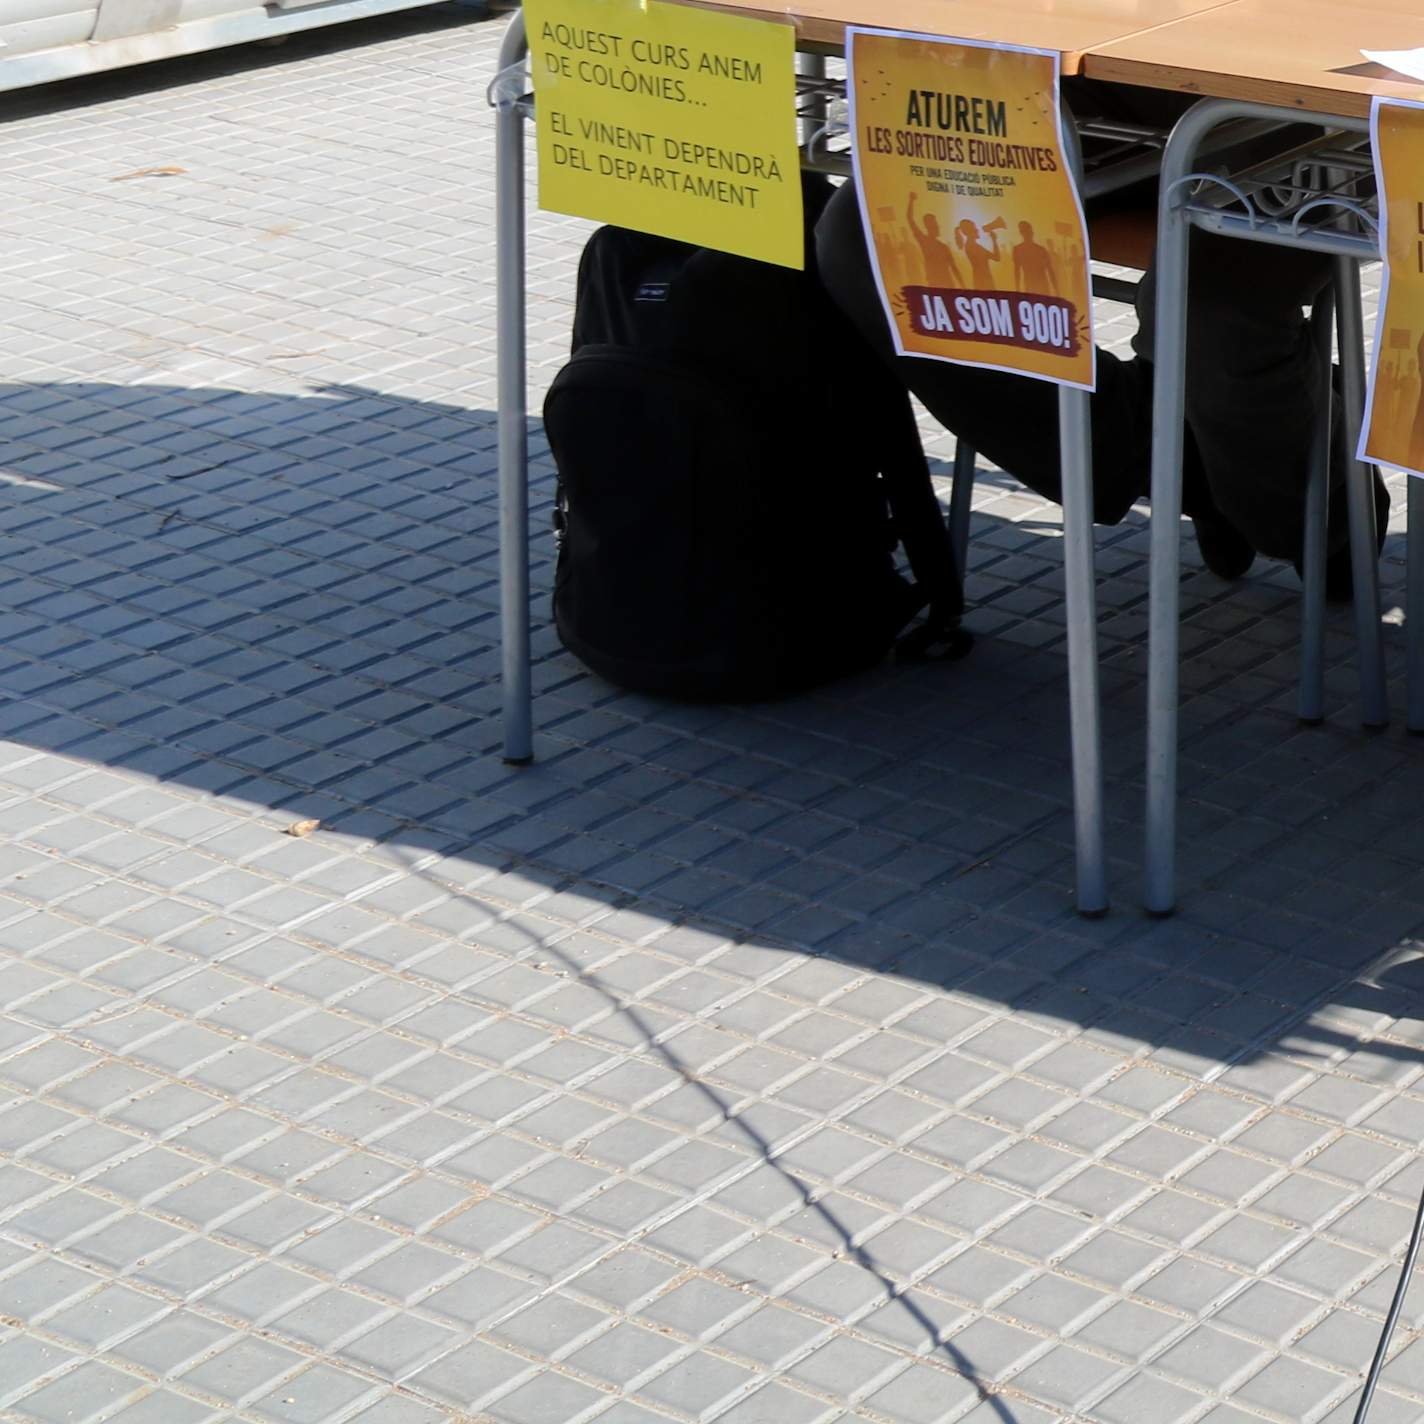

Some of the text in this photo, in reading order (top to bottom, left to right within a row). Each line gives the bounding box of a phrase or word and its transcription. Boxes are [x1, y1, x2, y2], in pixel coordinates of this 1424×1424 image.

[541, 21, 763, 85] AQUEST CURS ANEM
[544, 52, 707, 107] DE COLÒNIES...
[907, 89, 1008, 138] ATUREM
[550, 111, 783, 182] EL VINENT DEPENDRÀ
[867, 126, 1058, 173] LES SORTIDES EDUCATIVES
[552, 143, 759, 209] DEL DEPARTAMENT
[1417, 240, 1424, 274] I
[920, 293, 1072, 349] JA SOM 900!
